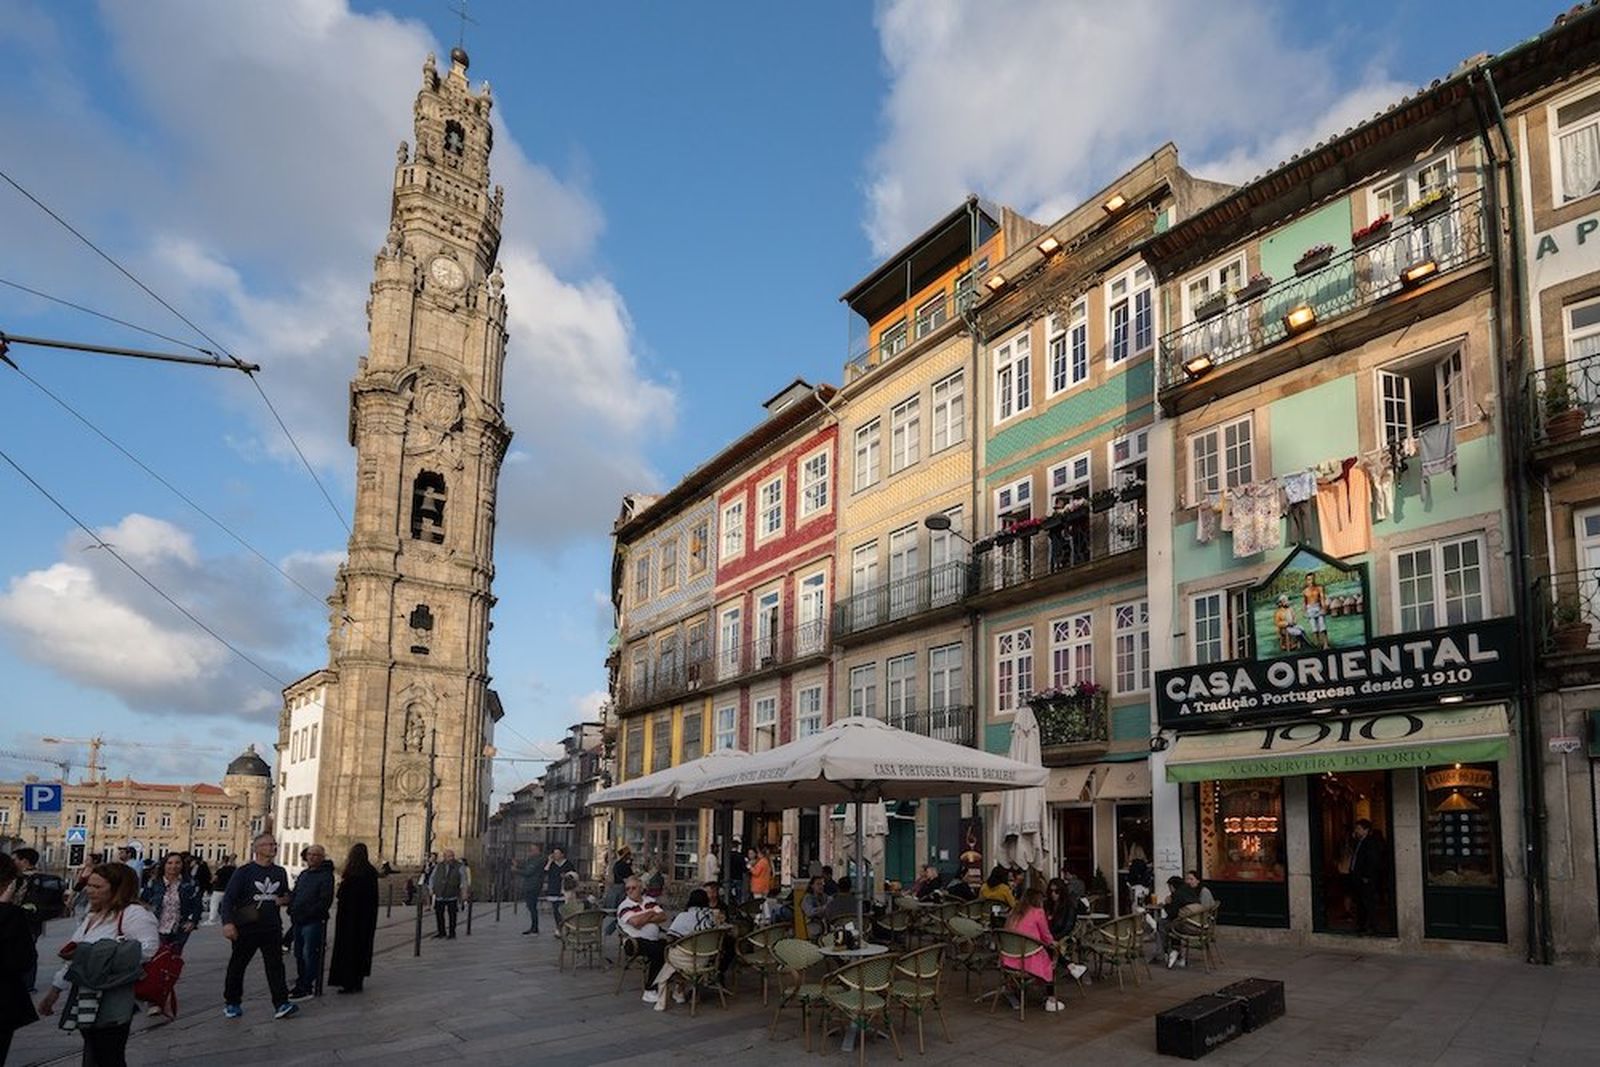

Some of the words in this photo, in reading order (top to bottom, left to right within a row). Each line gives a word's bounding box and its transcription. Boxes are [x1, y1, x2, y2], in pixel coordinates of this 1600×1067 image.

[1166, 667, 1257, 701] CASA
[1267, 633, 1499, 688] ORIENTAL
[1179, 703, 1190, 715] A
[1193, 696, 1258, 713] Tradição
[1262, 686, 1355, 706] Portuguesa
[1360, 676, 1414, 694] desde
[1422, 668, 1472, 687] 1910
[1260, 714, 1423, 749] 1910
[874, 763, 897, 776] CASA
[899, 764, 950, 778] PORTUGUESA
[952, 765, 979, 779] PASTEL
[1240, 758, 1336, 774] CONSERVEIRA
[1344, 755, 1368, 766] DO
[1376, 750, 1432, 764] PORTO
[32, 786, 55, 811] P
